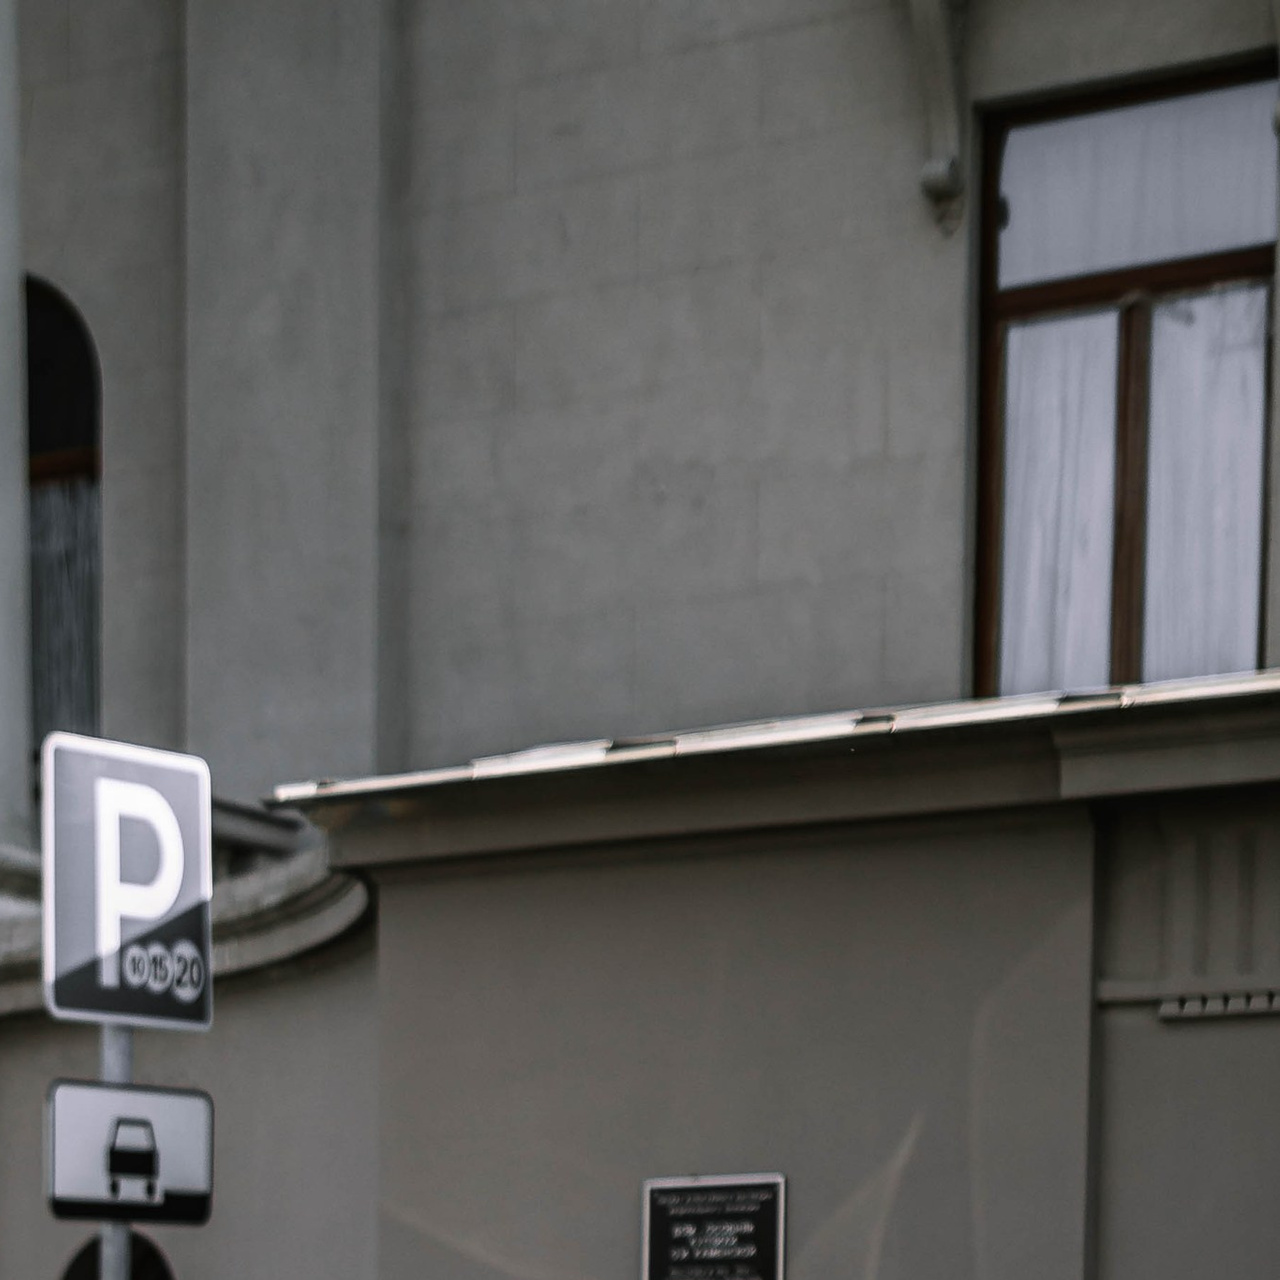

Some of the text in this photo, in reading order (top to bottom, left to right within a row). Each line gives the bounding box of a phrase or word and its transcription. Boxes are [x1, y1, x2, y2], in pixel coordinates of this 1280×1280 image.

[94, 776, 185, 988] P
[151, 954, 169, 984] 15
[175, 954, 202, 989] 20
